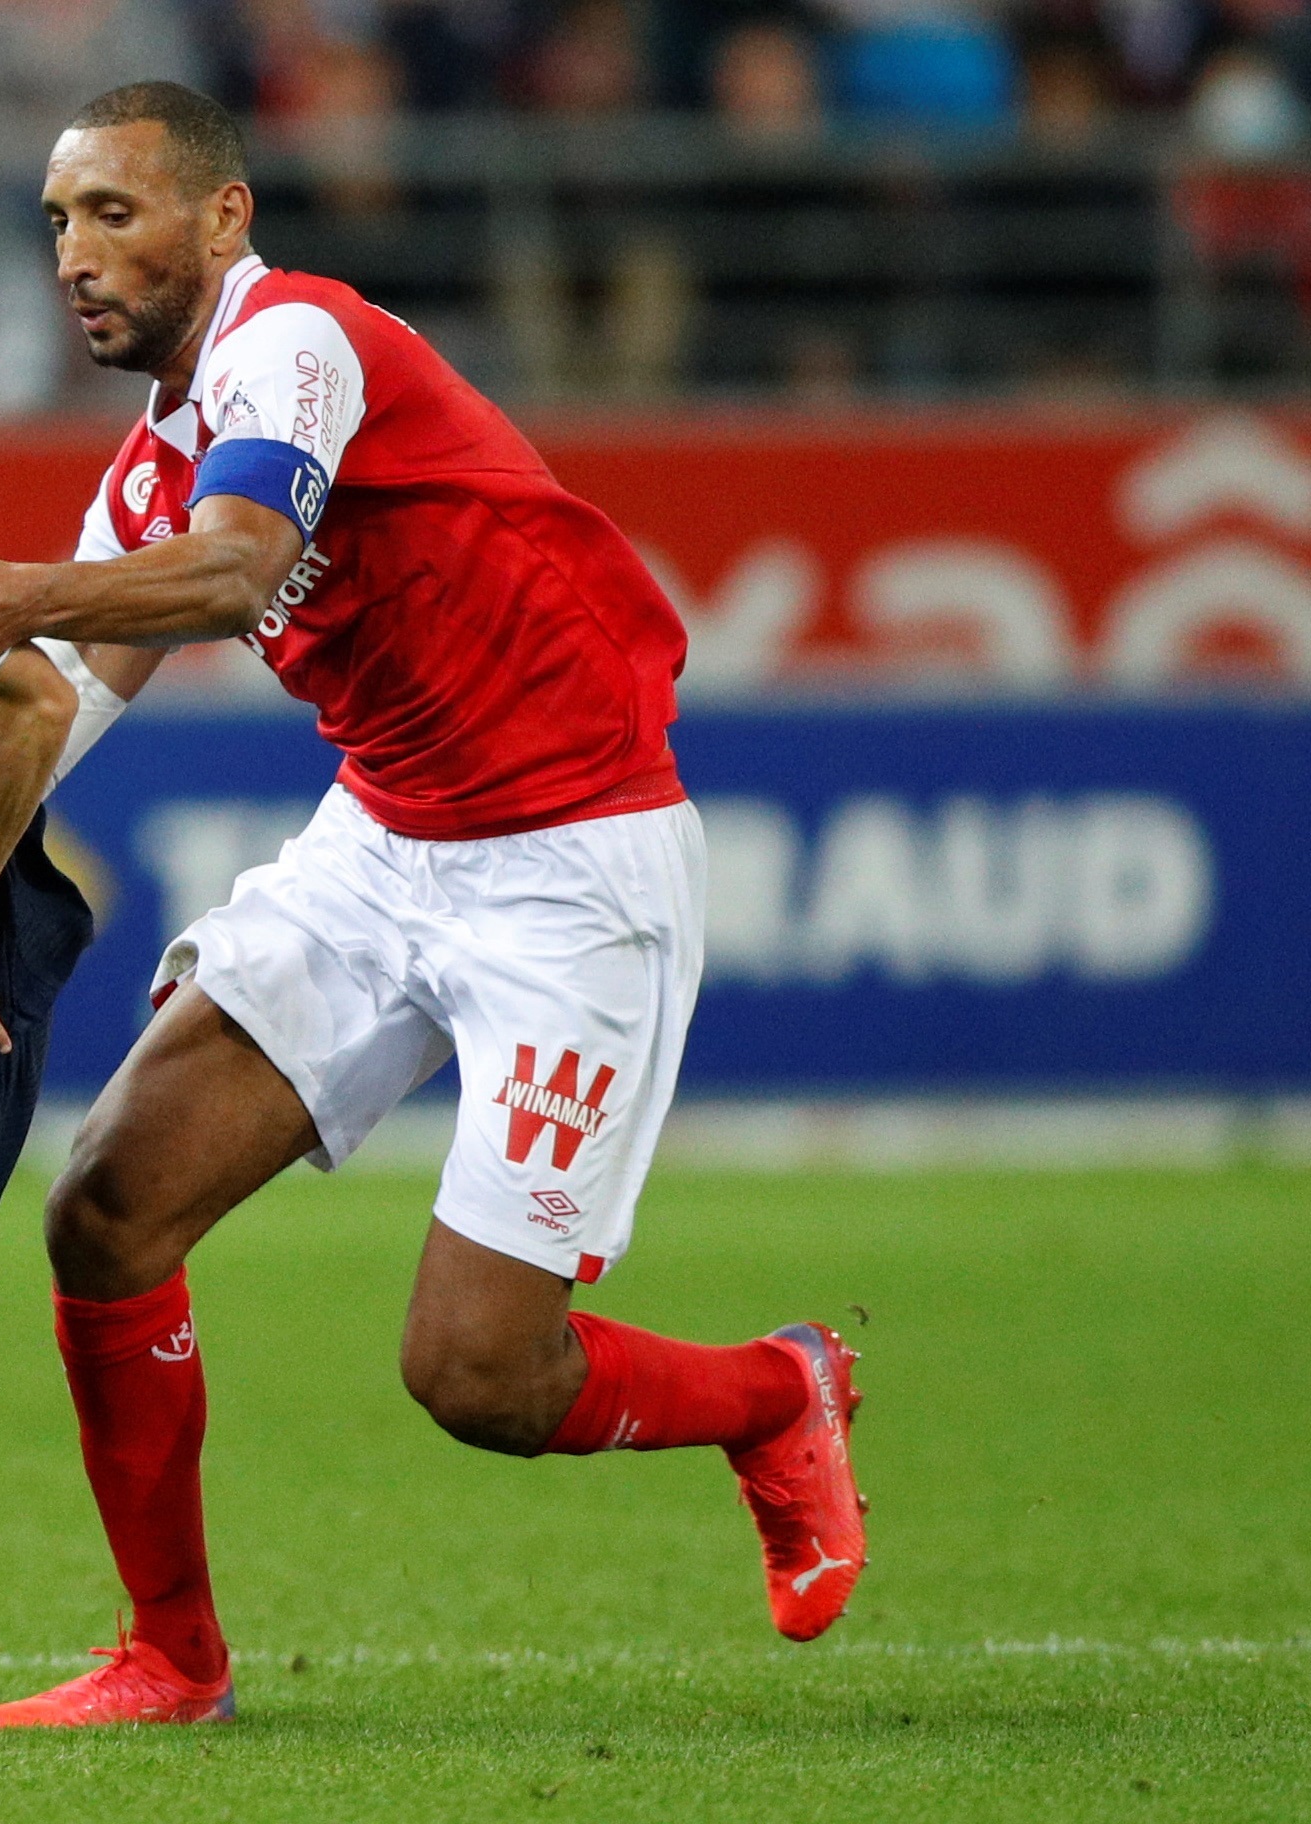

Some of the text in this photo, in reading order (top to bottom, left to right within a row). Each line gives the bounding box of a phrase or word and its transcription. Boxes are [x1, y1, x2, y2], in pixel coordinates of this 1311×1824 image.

[321, 360, 340, 454] REIMS
[504, 1078, 601, 1138] WINAMAX
[527, 1211, 570, 1235] umbro
